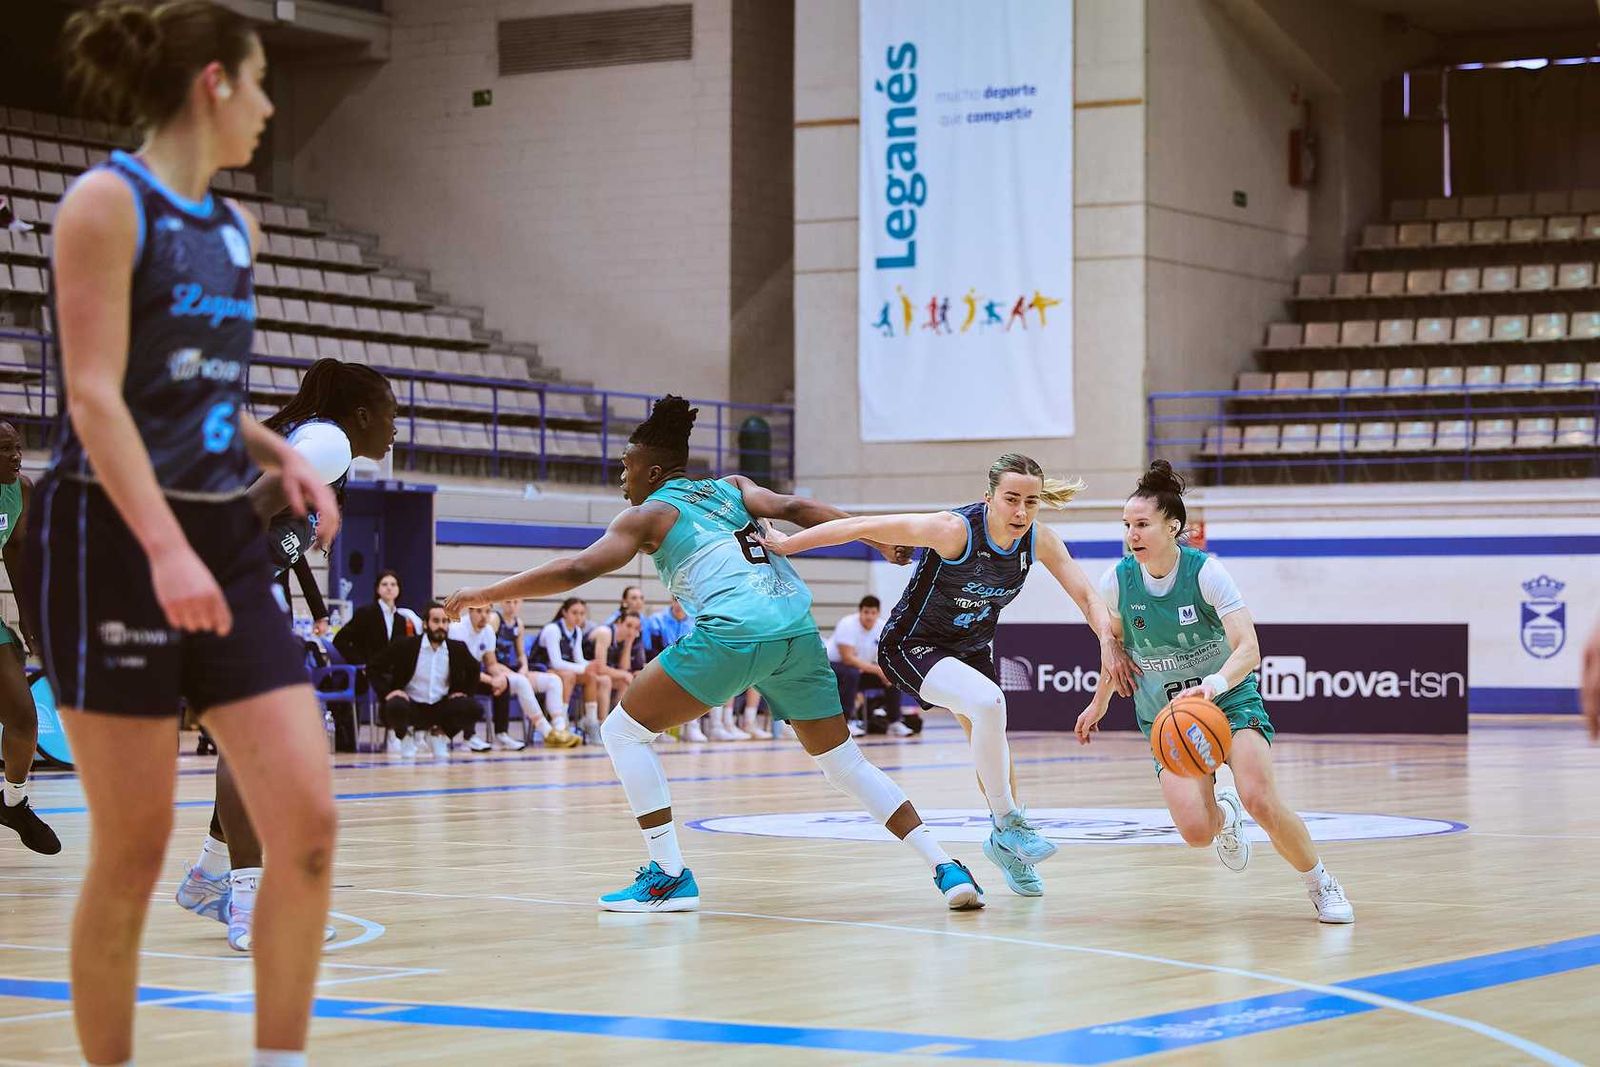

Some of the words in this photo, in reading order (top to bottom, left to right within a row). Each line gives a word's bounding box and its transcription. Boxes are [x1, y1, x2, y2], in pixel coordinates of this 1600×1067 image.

[983, 85, 1036, 101] deporte
[966, 107, 1032, 125] compartir
[875, 41, 927, 269] Leganés
[202, 401, 234, 453] 6
[1262, 656, 1466, 701] innova-tsn
